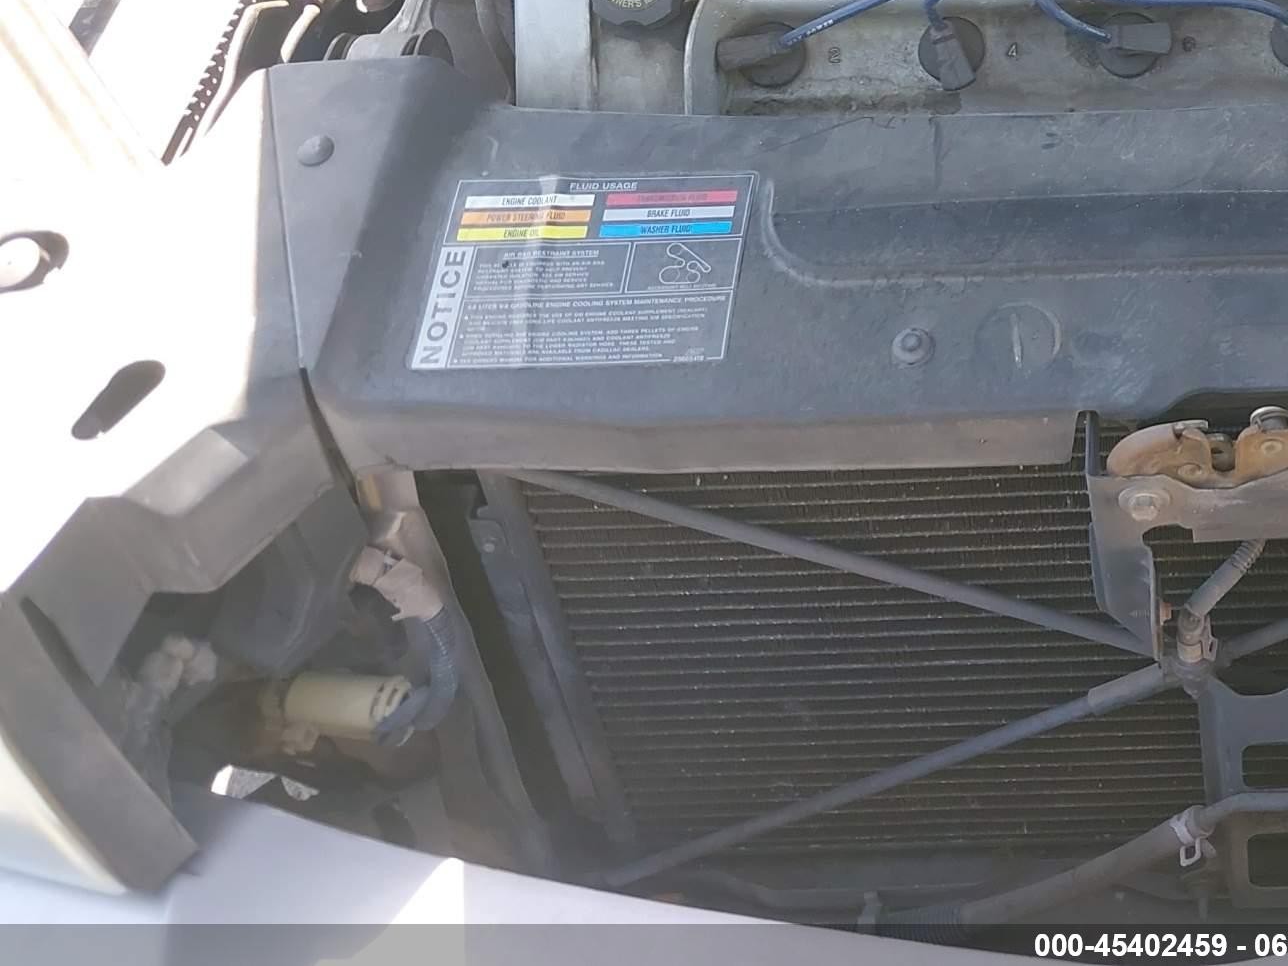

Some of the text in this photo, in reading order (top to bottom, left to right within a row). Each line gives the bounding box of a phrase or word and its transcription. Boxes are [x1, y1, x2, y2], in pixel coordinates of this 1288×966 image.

[570, 181, 638, 191] FLUID USAGE
[502, 196, 557, 206] ENGINE COOLANT
[487, 213, 511, 222] POWER
[546, 211, 566, 220] FLUID
[647, 209, 691, 218] BRAKE FLUID
[504, 228, 527, 237] ENGINE
[641, 224, 691, 234] WASHER FLUID
[420, 251, 466, 364] NOTICE
